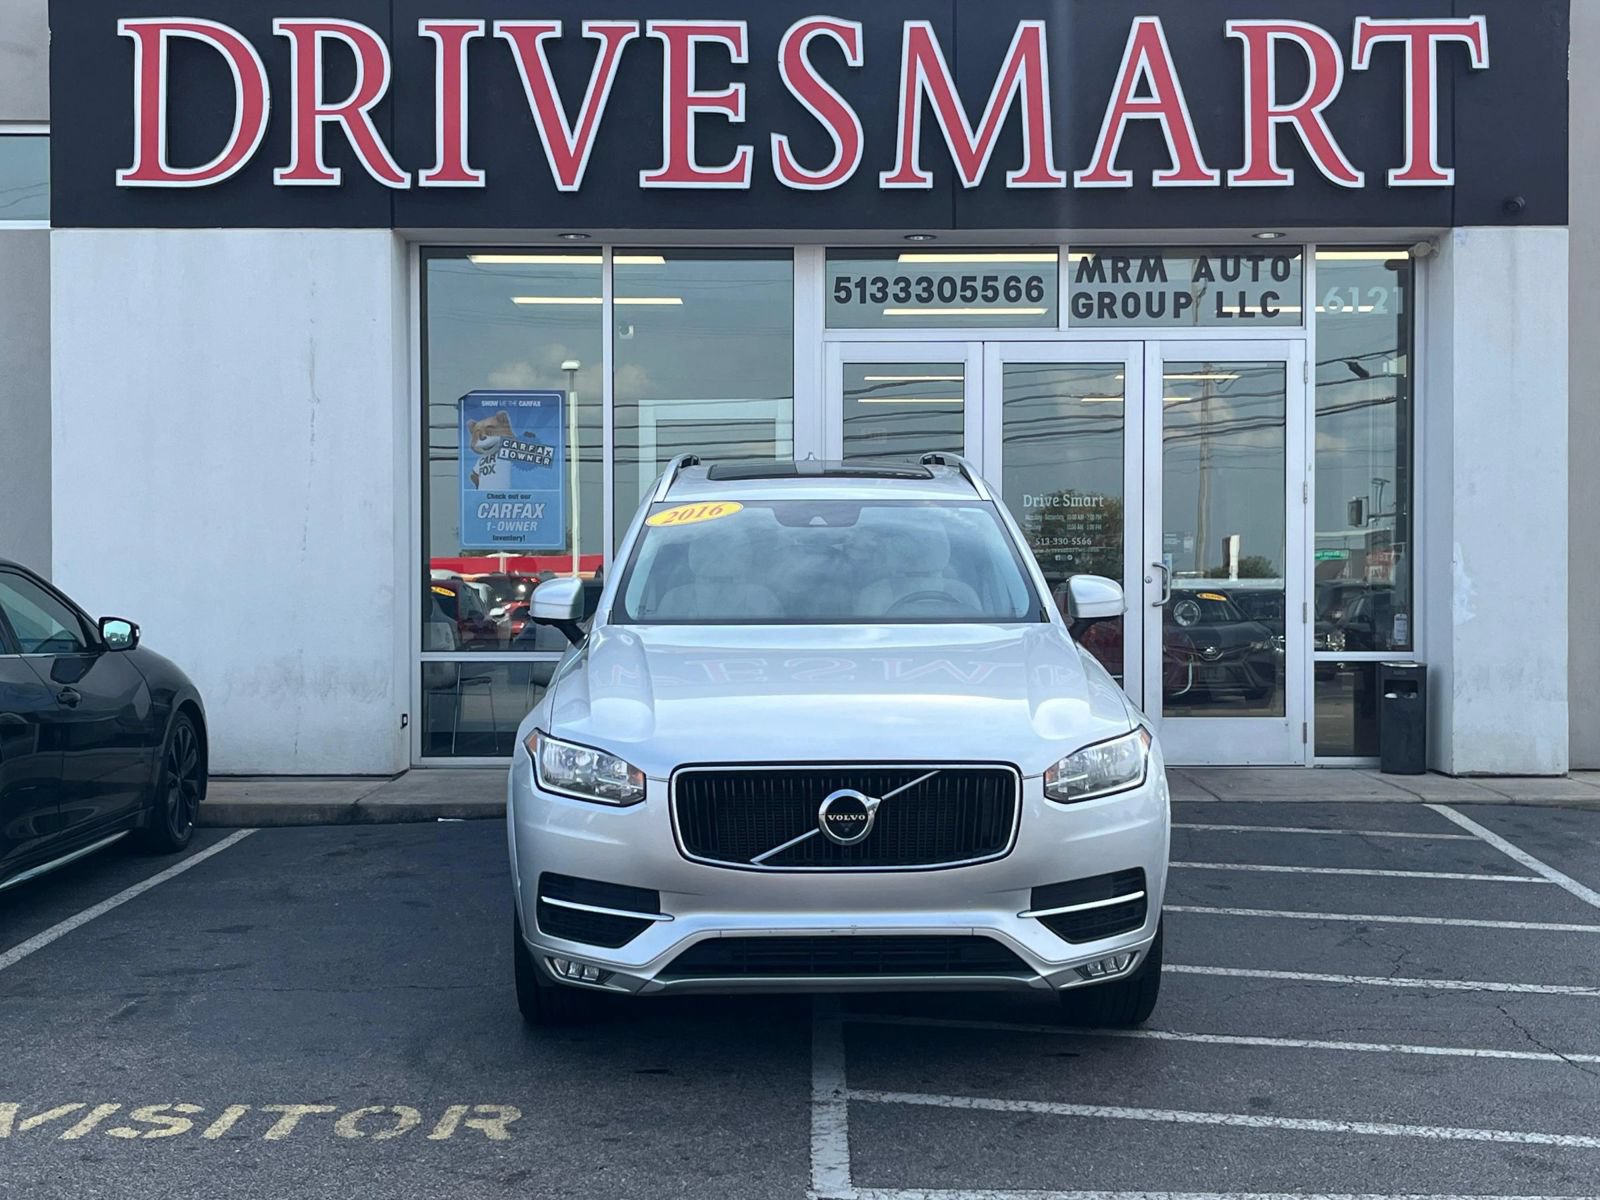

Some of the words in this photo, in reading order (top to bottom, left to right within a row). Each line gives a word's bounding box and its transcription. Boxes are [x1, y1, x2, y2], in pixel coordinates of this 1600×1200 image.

[114, 14, 1490, 193] DRIVESMART
[1075, 255, 1168, 284] MRM
[1192, 255, 1291, 283] AUTO
[833, 275, 1044, 304] 5133305566
[1071, 290, 1193, 319] GROUP
[1215, 290, 1281, 318] LLC
[1322, 286, 1404, 315] 6121
[502, 440, 554, 457] CARFAX
[509, 452, 551, 465] OWNER
[479, 464, 497, 476] FOX
[477, 502, 545, 519] CARFAX
[1023, 494, 1060, 508] Drive
[1062, 494, 1105, 508] Smart
[660, 503, 724, 524] 2016
[486, 521, 538, 532] 1-OWNER
[1035, 536, 1092, 546] 513-330-5566
[0, 1102, 522, 1141] VISITOR
